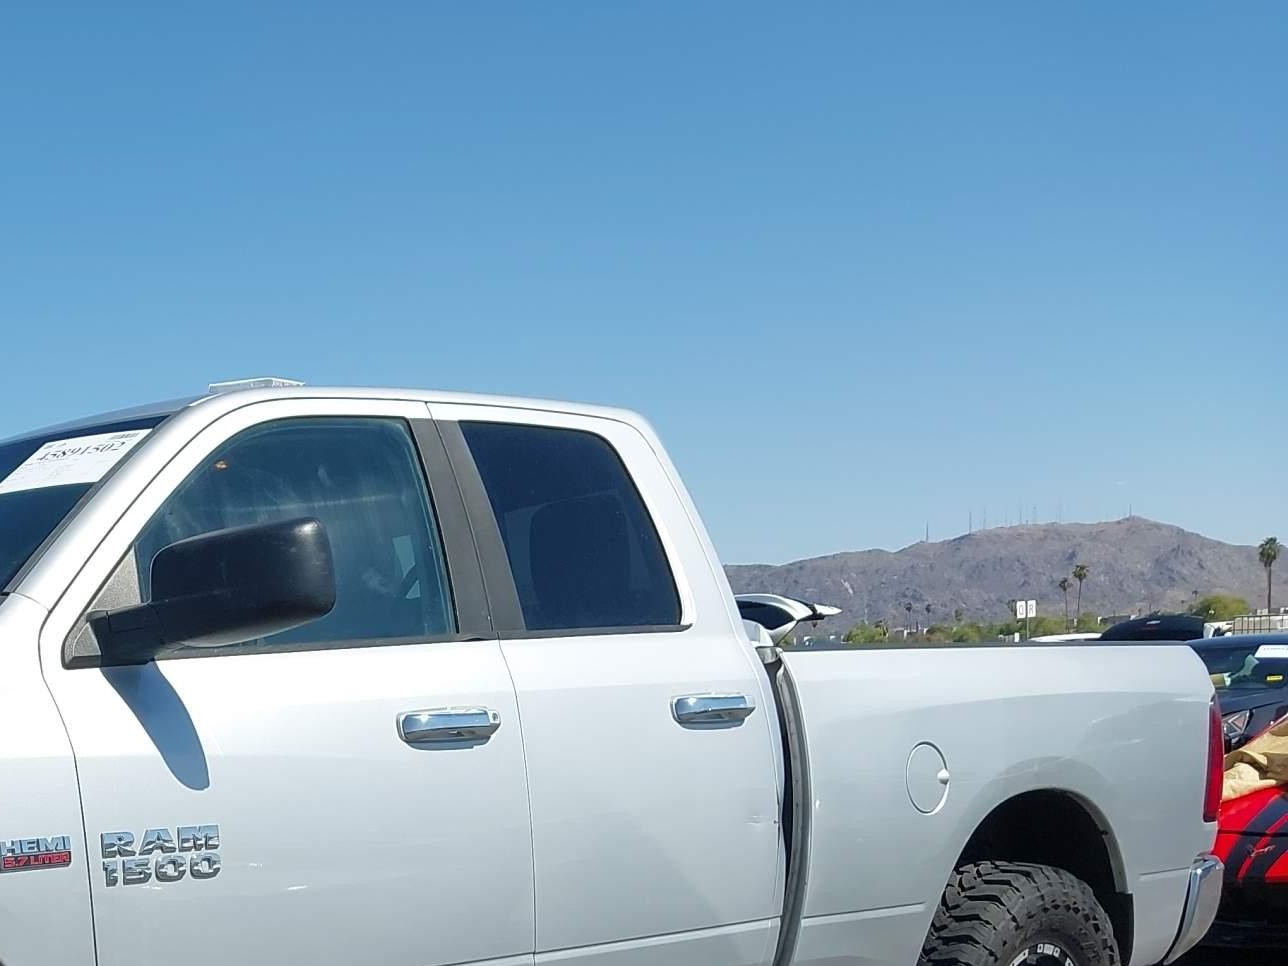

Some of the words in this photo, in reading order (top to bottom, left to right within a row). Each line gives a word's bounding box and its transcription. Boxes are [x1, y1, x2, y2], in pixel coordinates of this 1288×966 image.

[37, 440, 126, 461] 45891502
[100, 824, 220, 858] RAM
[3, 855, 28, 869] 5.7
[29, 852, 70, 866] LITER
[103, 852, 220, 887] 1500
